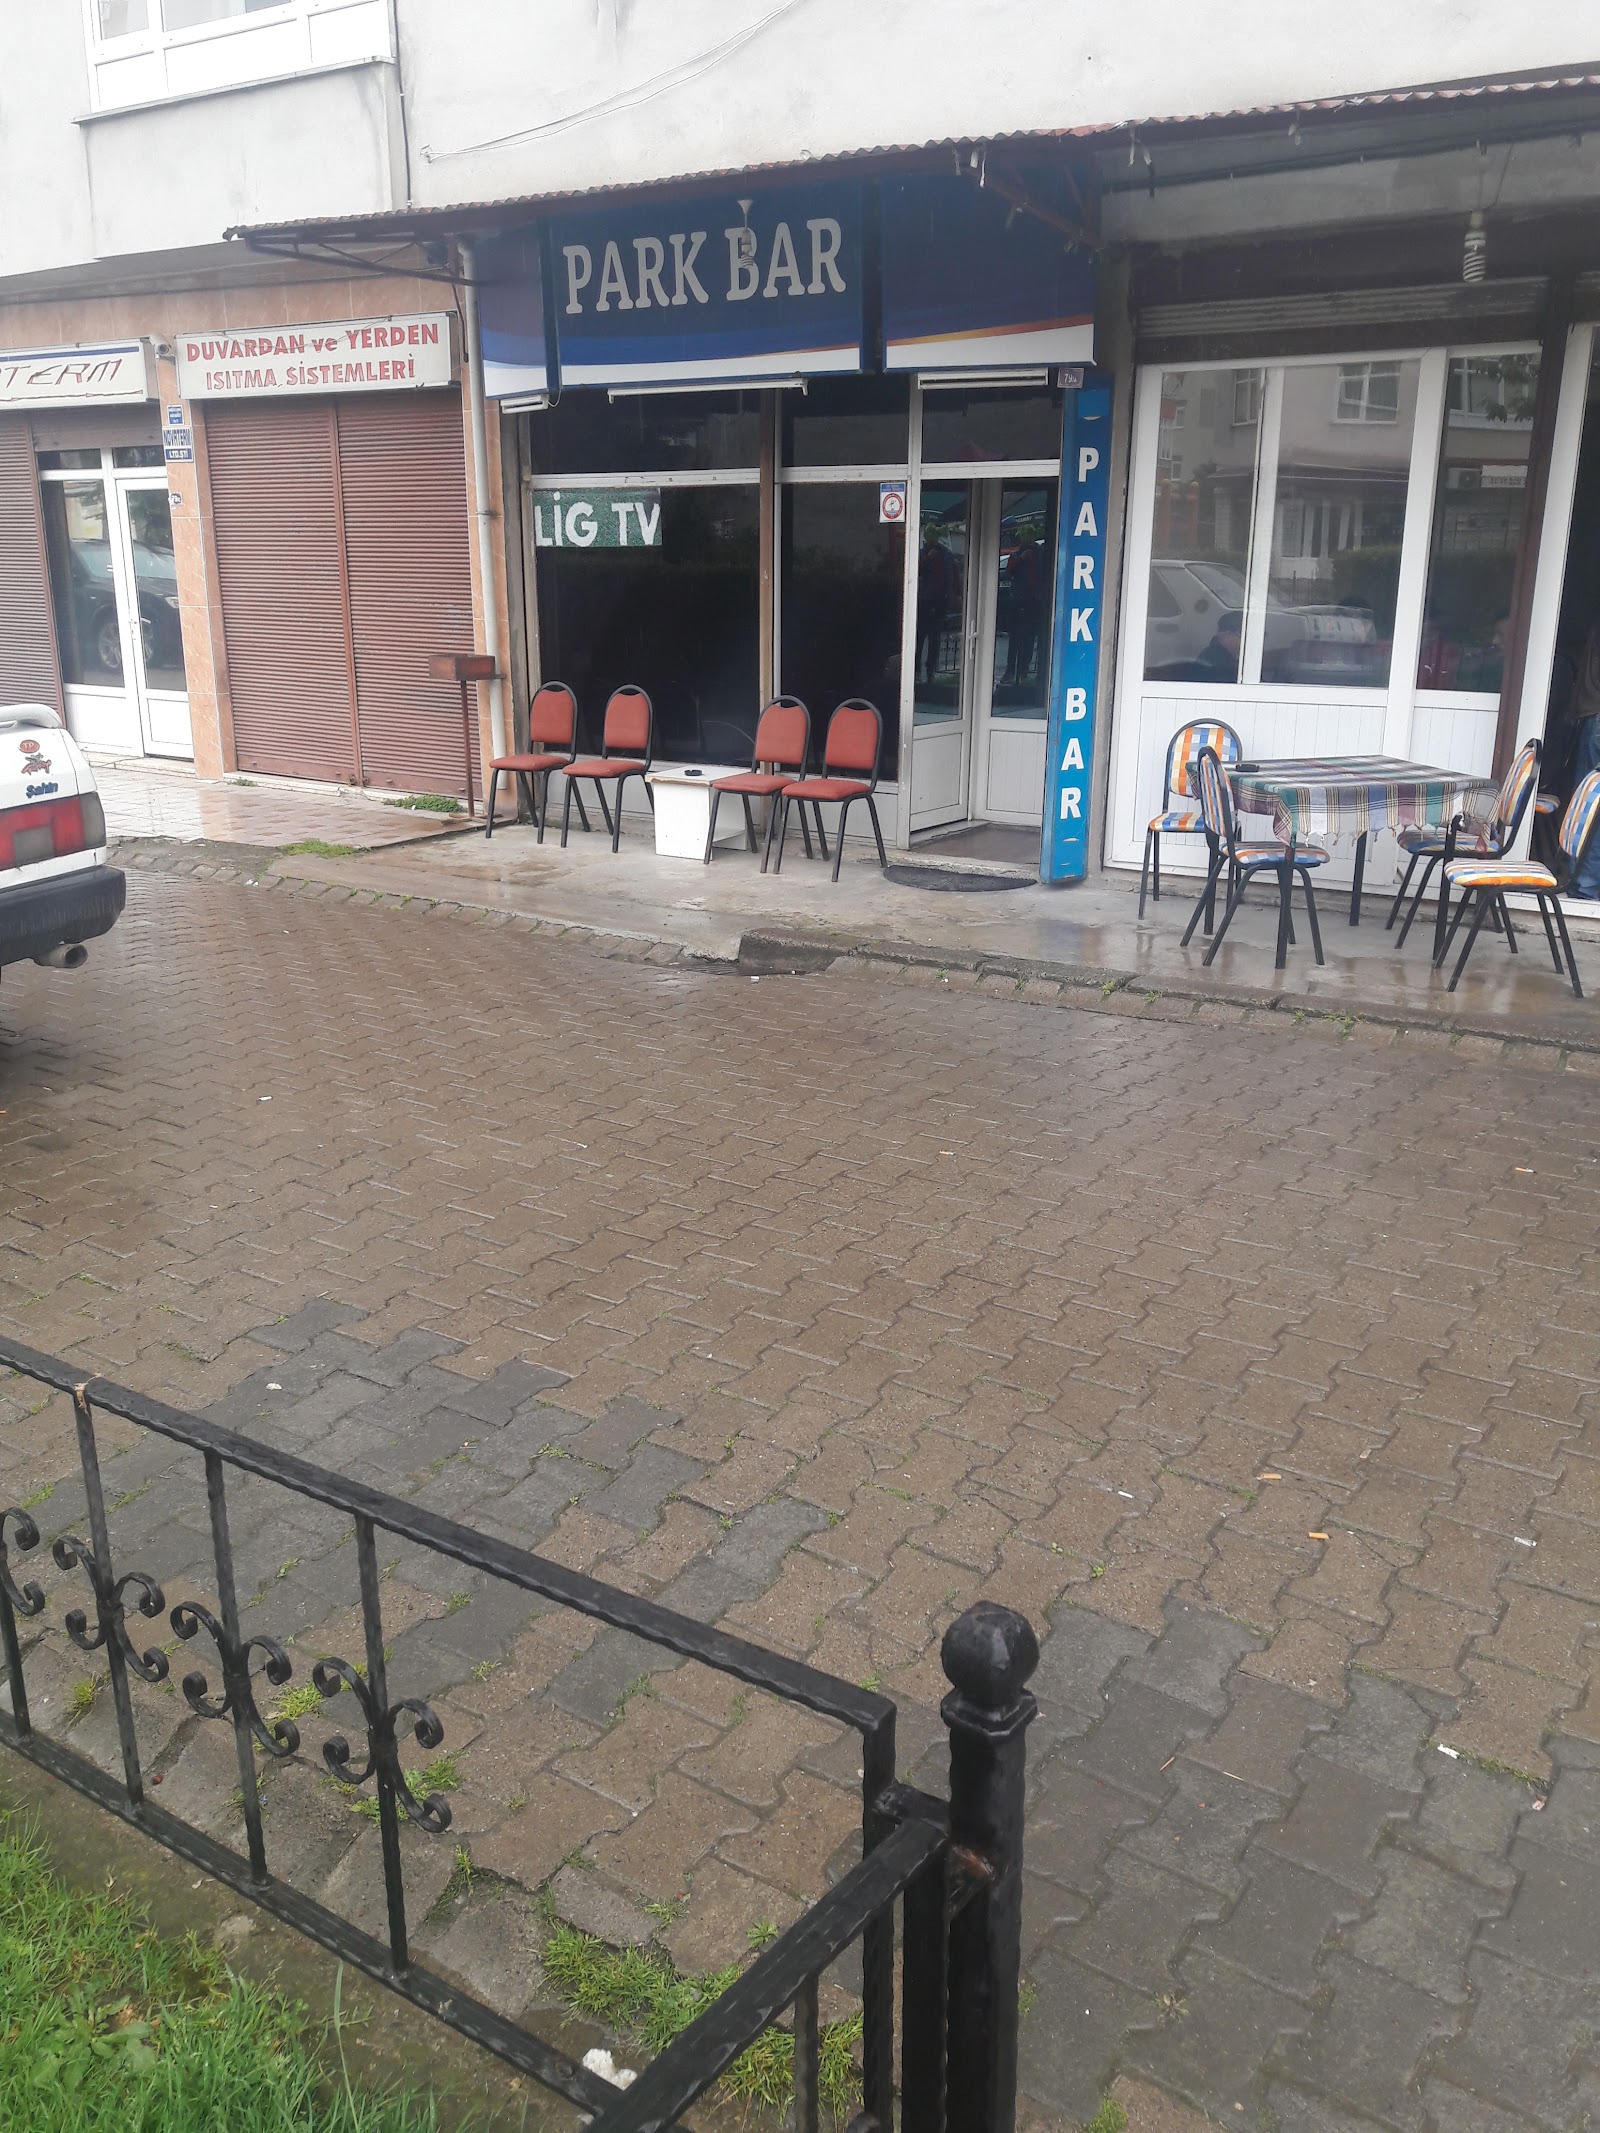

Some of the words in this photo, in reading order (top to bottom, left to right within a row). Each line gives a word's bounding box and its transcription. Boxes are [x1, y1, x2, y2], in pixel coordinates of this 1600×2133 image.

[562, 231, 709, 314] PARK
[724, 217, 846, 301] BAR
[187, 334, 304, 361] DUVARDAN
[311, 337, 338, 353] ve
[345, 323, 439, 350] YERDEN
[0, 358, 122, 388] TERM
[206, 368, 277, 390] ISITMA
[286, 353, 415, 386] SİSTEMLERİ
[534, 491, 598, 547] LİG
[611, 502, 660, 546] TV
[1069, 447, 1100, 643] PARK
[1060, 687, 1087, 820] BAR
